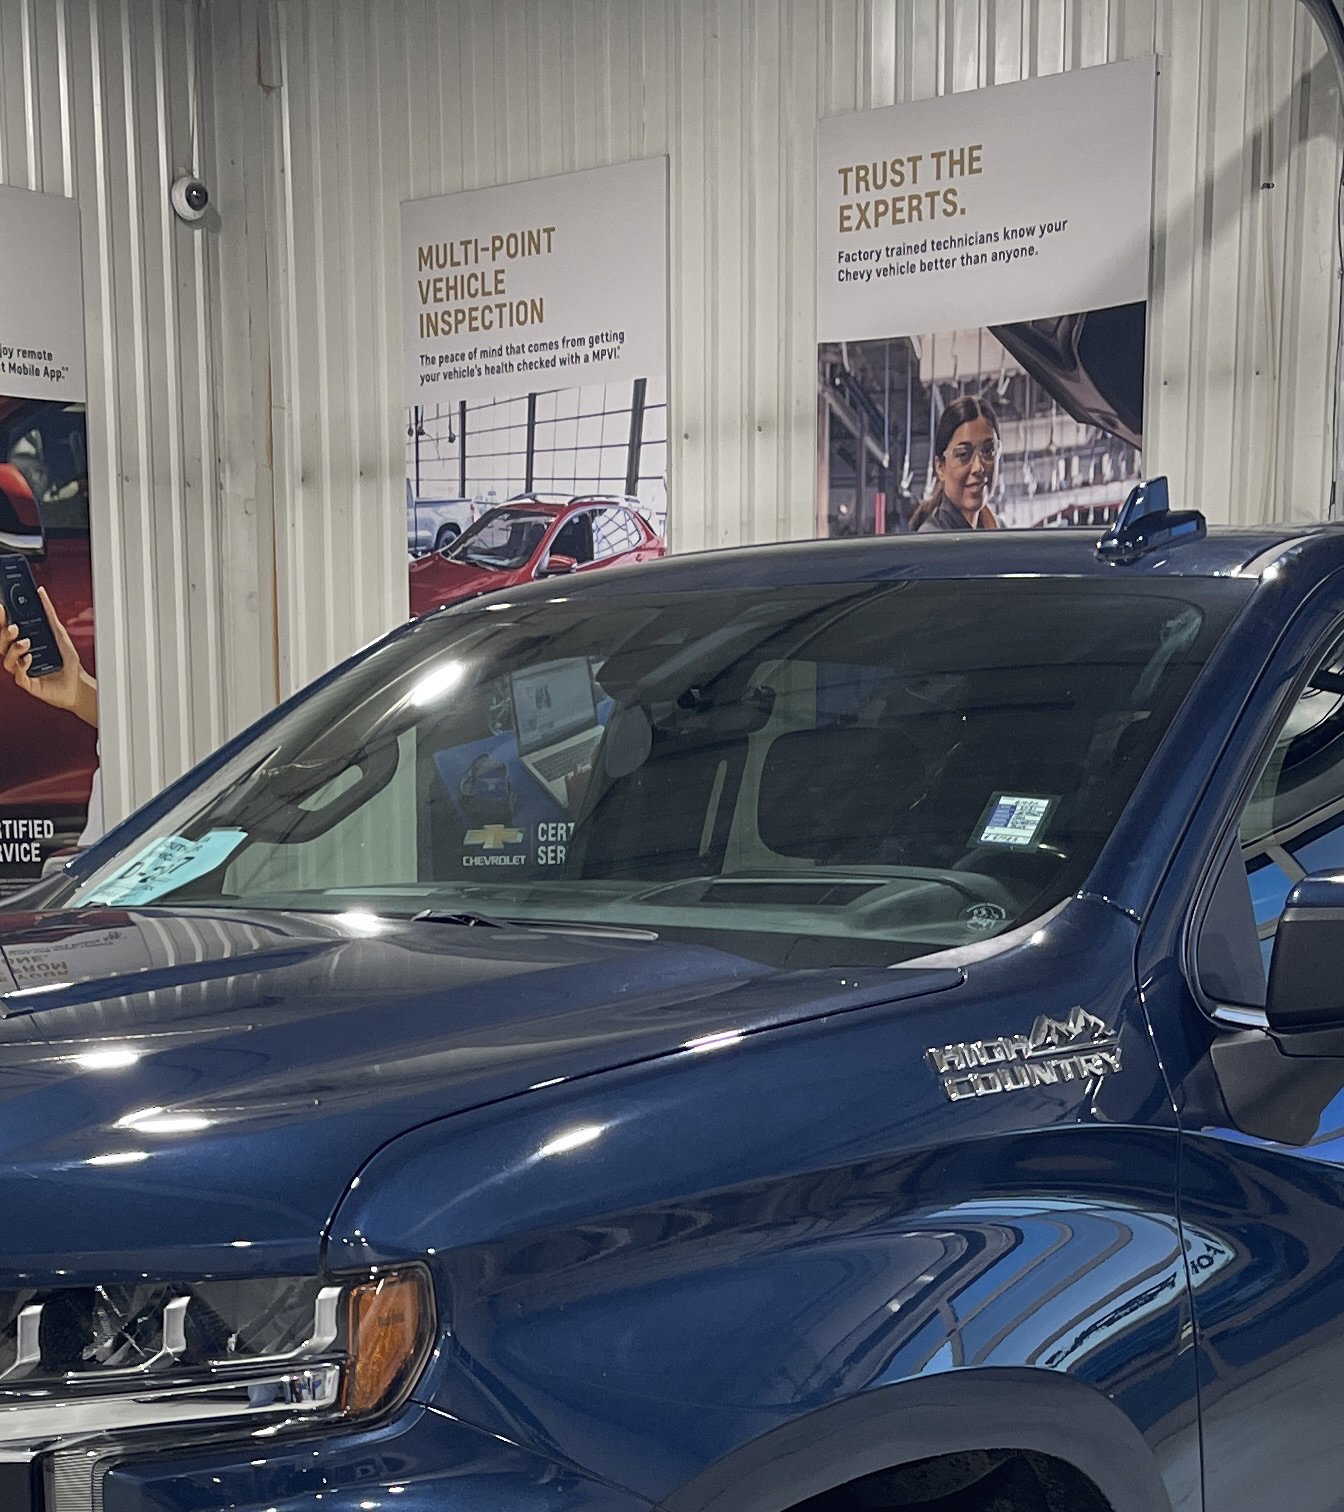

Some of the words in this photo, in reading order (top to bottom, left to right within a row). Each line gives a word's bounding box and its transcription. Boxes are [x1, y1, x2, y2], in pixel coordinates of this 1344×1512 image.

[838, 154, 923, 196] TRUST
[930, 144, 983, 182] THE
[838, 188, 967, 233] EXPERTS.
[417, 226, 556, 272] MULTI-POINT
[837, 248, 883, 264] Factory
[885, 239, 928, 259] trained
[930, 229, 1000, 252] technicians
[1002, 223, 1037, 242] know
[1038, 219, 1069, 239] your
[837, 267, 873, 283] Chevy
[875, 260, 917, 279] vehicle
[919, 256, 958, 273] better
[960, 252, 988, 268] than
[990, 244, 1039, 266] anyone.
[417, 268, 506, 305] VEHICLE
[419, 297, 544, 339] INSPECTION
[16, 347, 54, 363] remote
[419, 353, 437, 368] The
[438, 350, 467, 370] peace
[467, 348, 478, 362] of
[479, 344, 504, 360] mind
[505, 341, 526, 357] that
[527, 338, 560, 355] comes
[561, 334, 586, 350] from
[588, 328, 625, 350] getting
[419, 371, 441, 387] your
[443, 362, 483, 381] vehicle's
[483, 359, 515, 377] health
[516, 354, 557, 374] checked
[558, 350, 582, 367] with
[583, 354, 590, 364] a
[7, 362, 41, 379] Mobile
[462, 855, 527, 867] CHEVROLET
[925, 1034, 1029, 1074] HIGH
[943, 1047, 1123, 1101] COUNTRY
